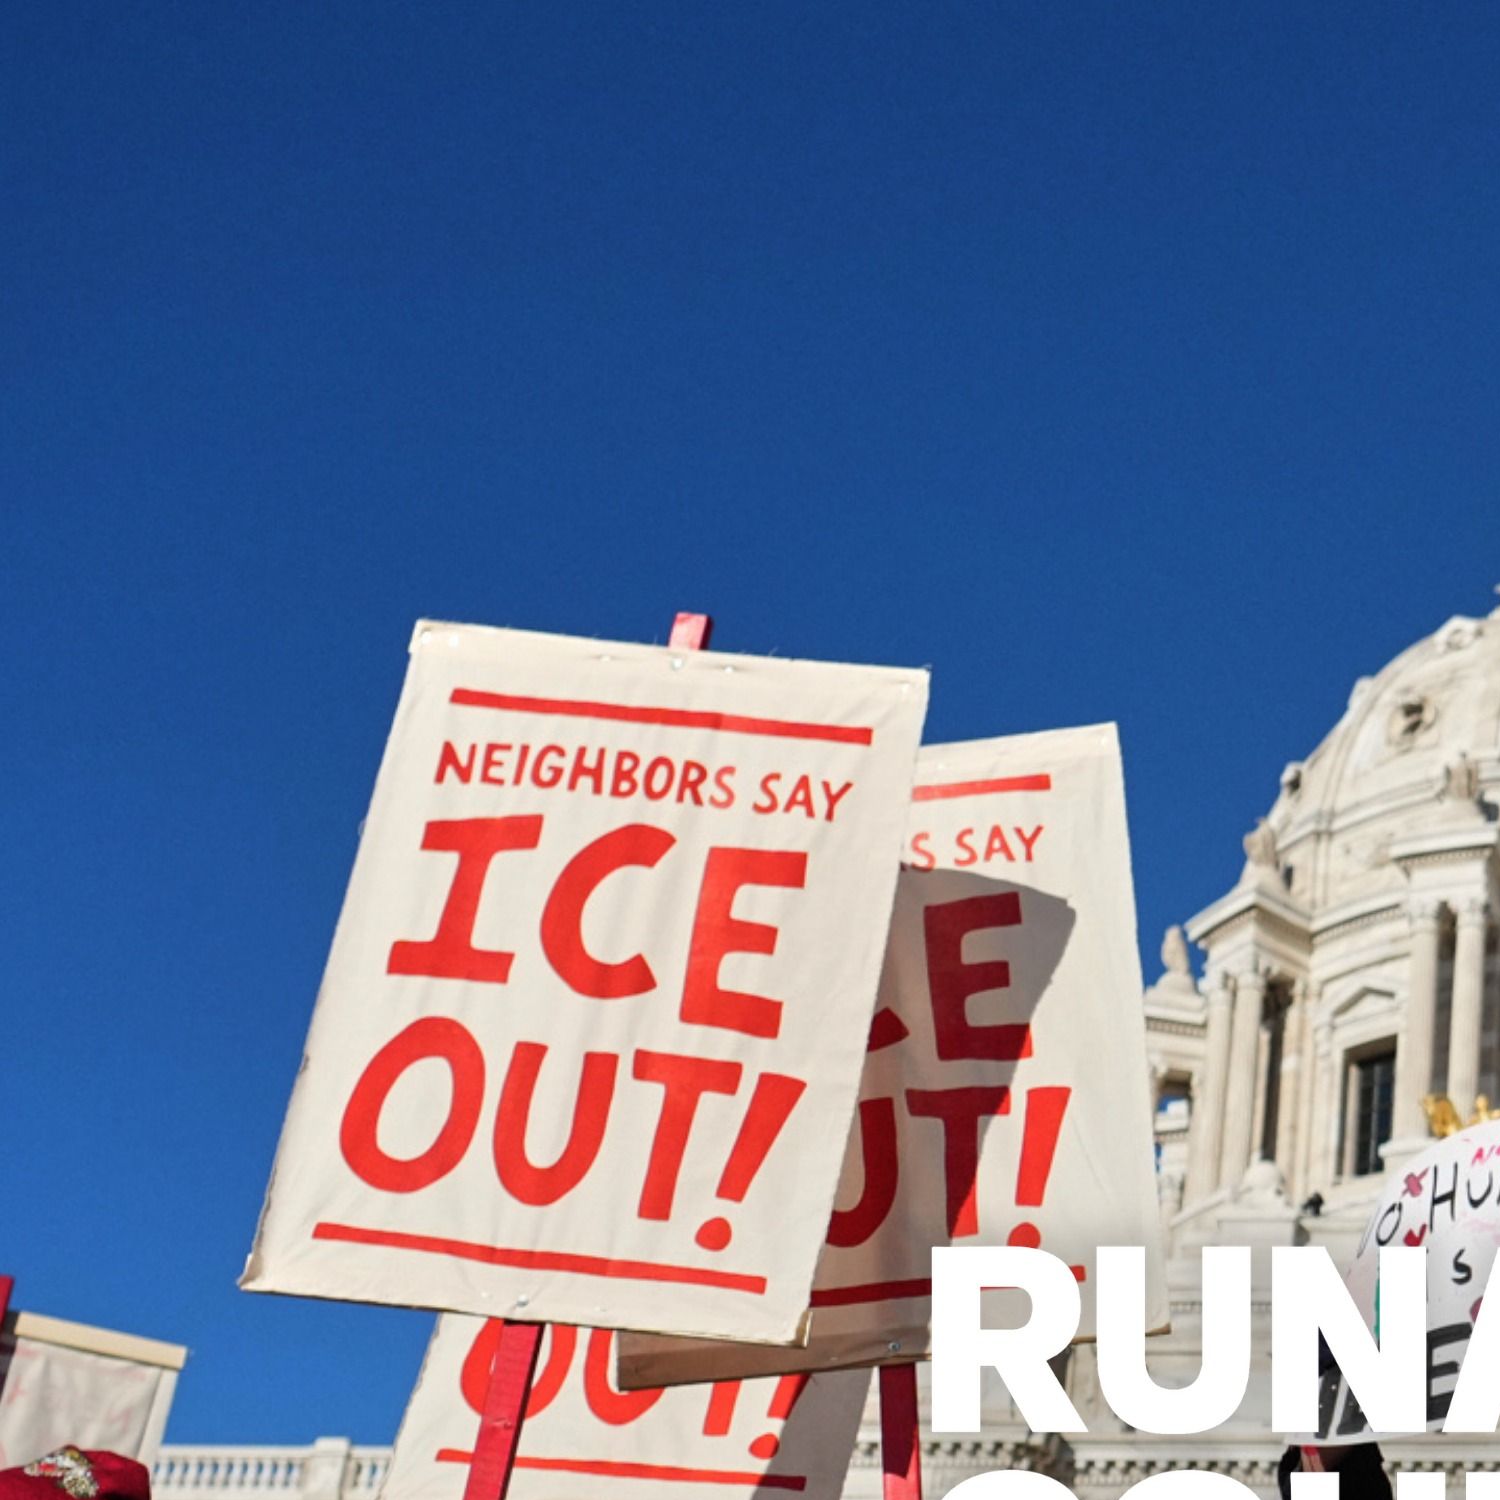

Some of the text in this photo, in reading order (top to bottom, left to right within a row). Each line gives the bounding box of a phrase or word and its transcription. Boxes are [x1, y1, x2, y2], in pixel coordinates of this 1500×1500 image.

[433, 740, 854, 822] NEIGHBORS SAY
[954, 824, 1045, 869] SAY
[386, 813, 808, 1040] ICE
[338, 1015, 808, 1252] OUT!
[825, 1086, 1072, 1249] UT!
